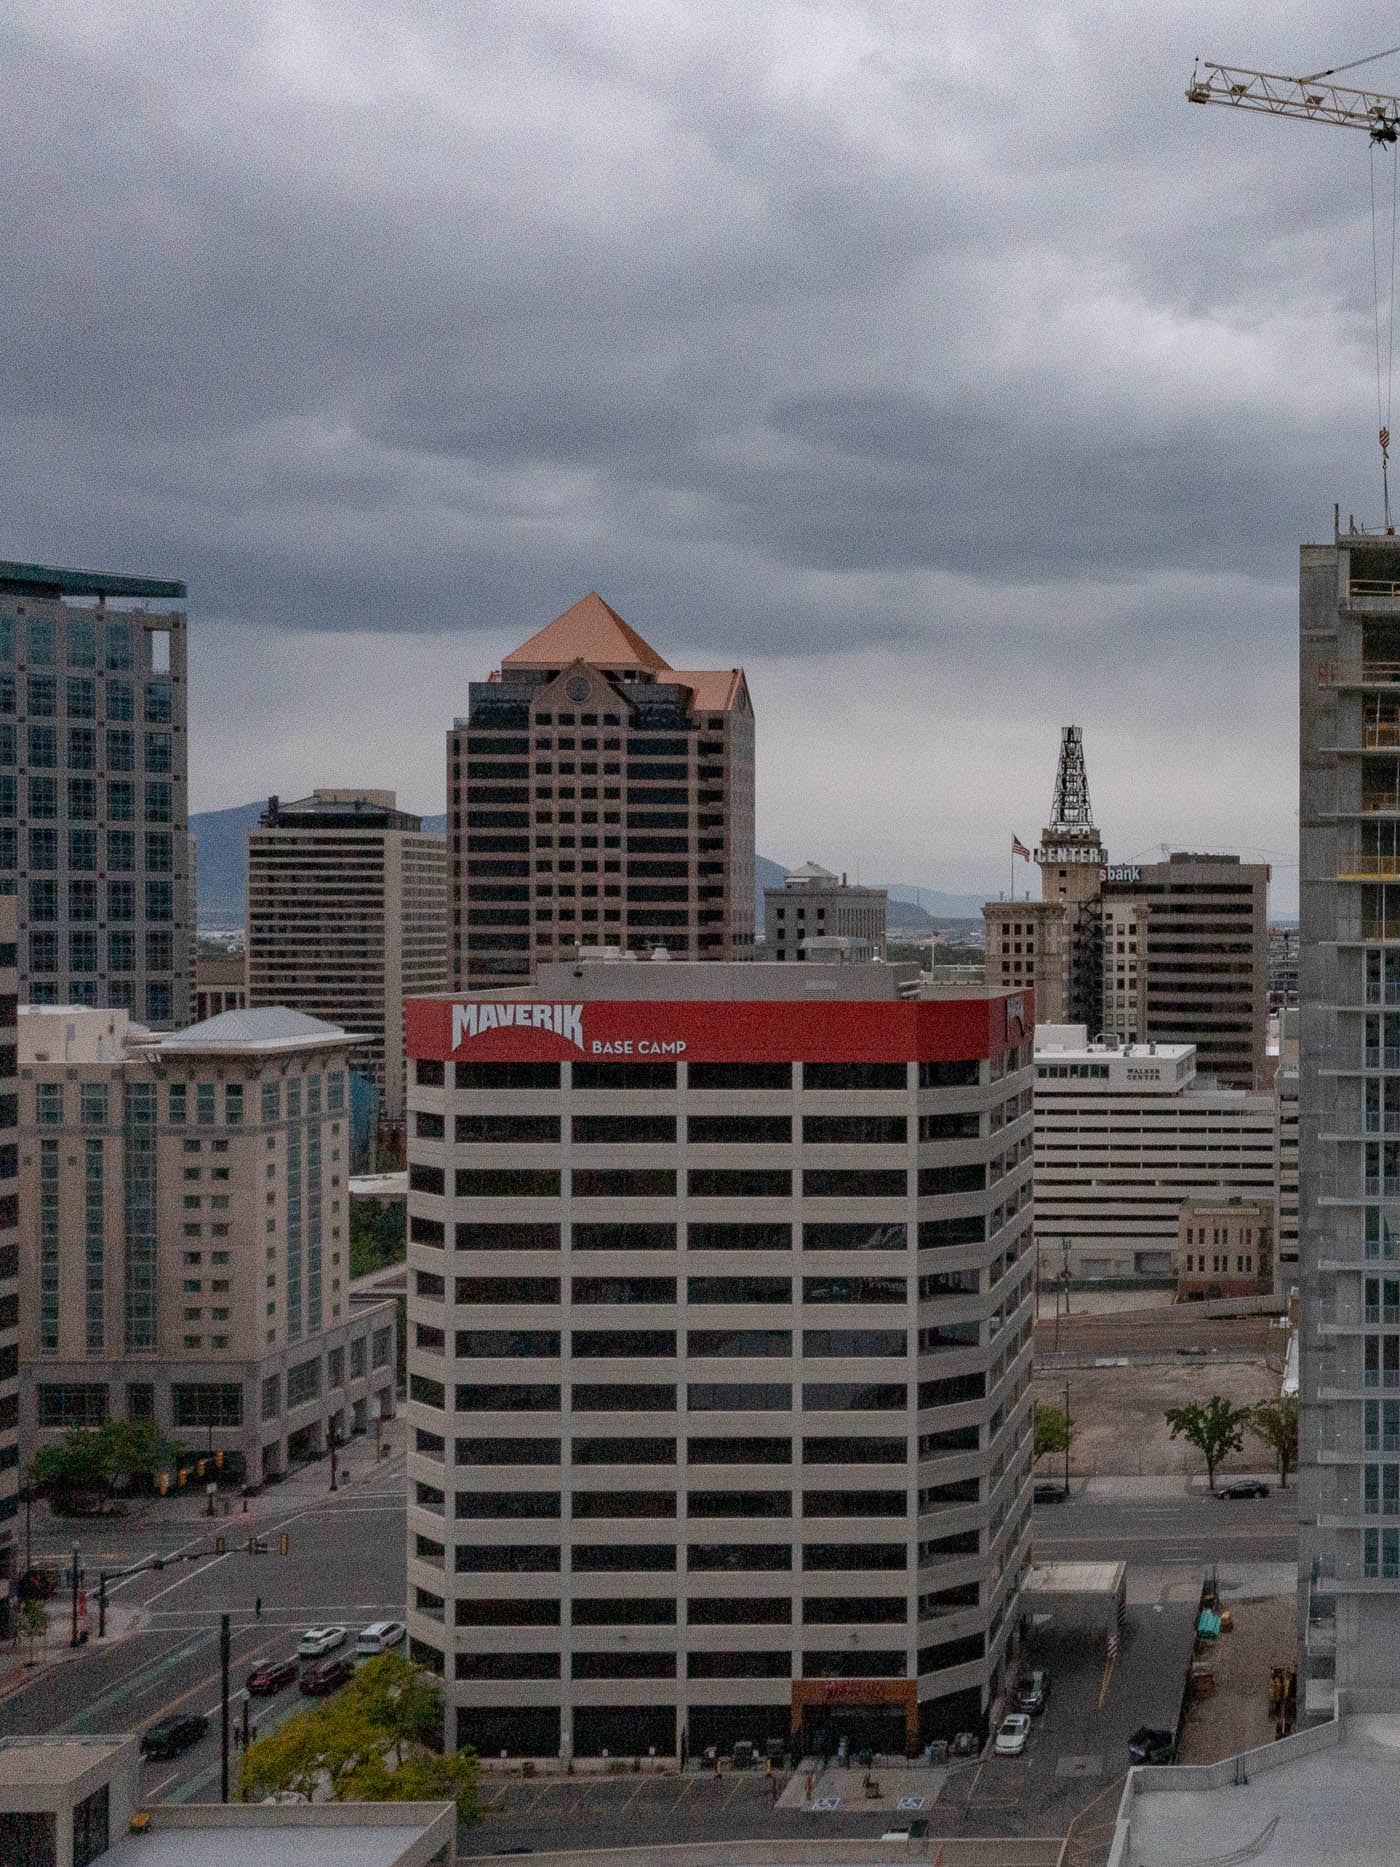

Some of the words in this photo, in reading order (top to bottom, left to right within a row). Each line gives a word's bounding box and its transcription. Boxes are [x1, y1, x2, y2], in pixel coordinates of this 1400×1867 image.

[1037, 848, 1098, 863] CENTER
[452, 1003, 585, 1052] MAVERIK
[592, 1040, 633, 1054] BASE
[638, 1040, 687, 1055] CAMP
